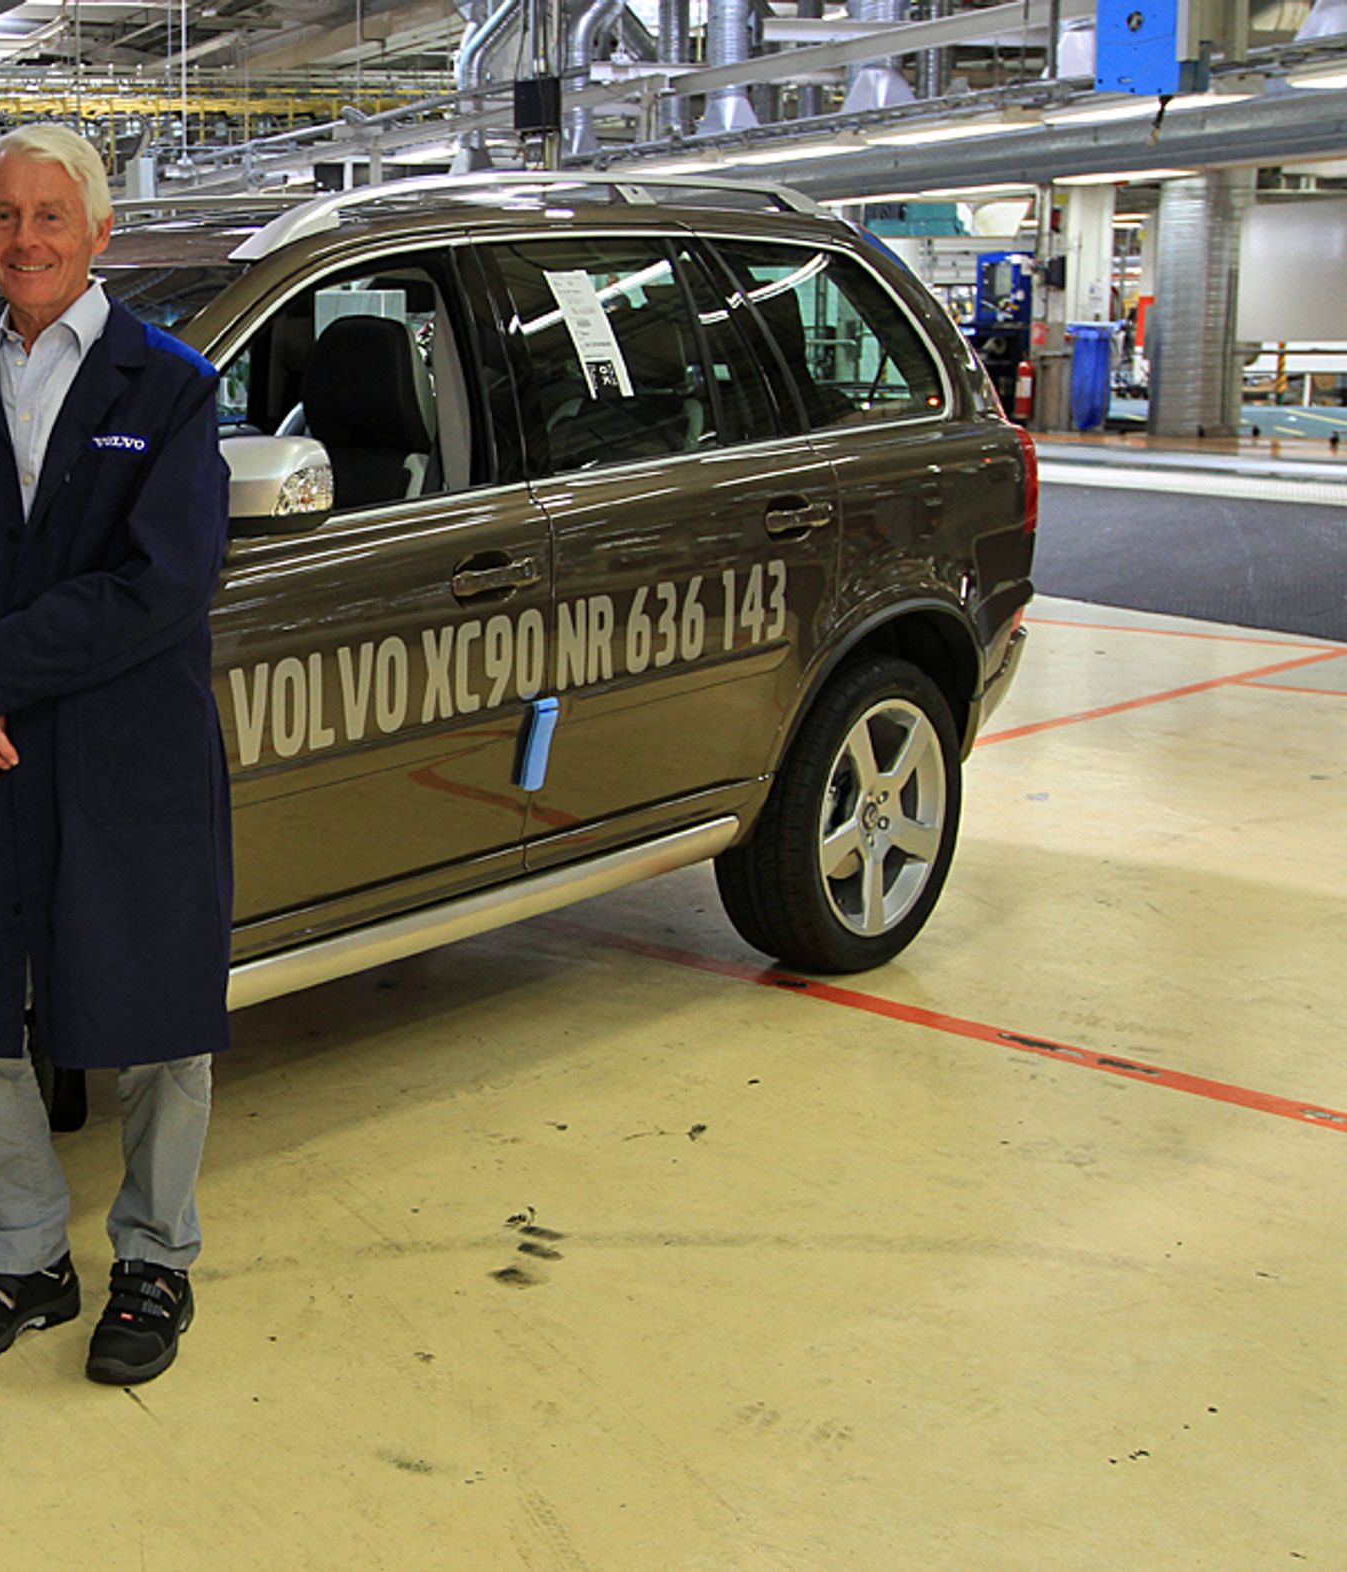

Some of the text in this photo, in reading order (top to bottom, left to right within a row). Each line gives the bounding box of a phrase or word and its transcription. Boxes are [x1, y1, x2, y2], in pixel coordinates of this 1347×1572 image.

[92, 436, 145, 450] VOLVO
[229, 560, 787, 766] VOLVO XC90 NR 636 143
